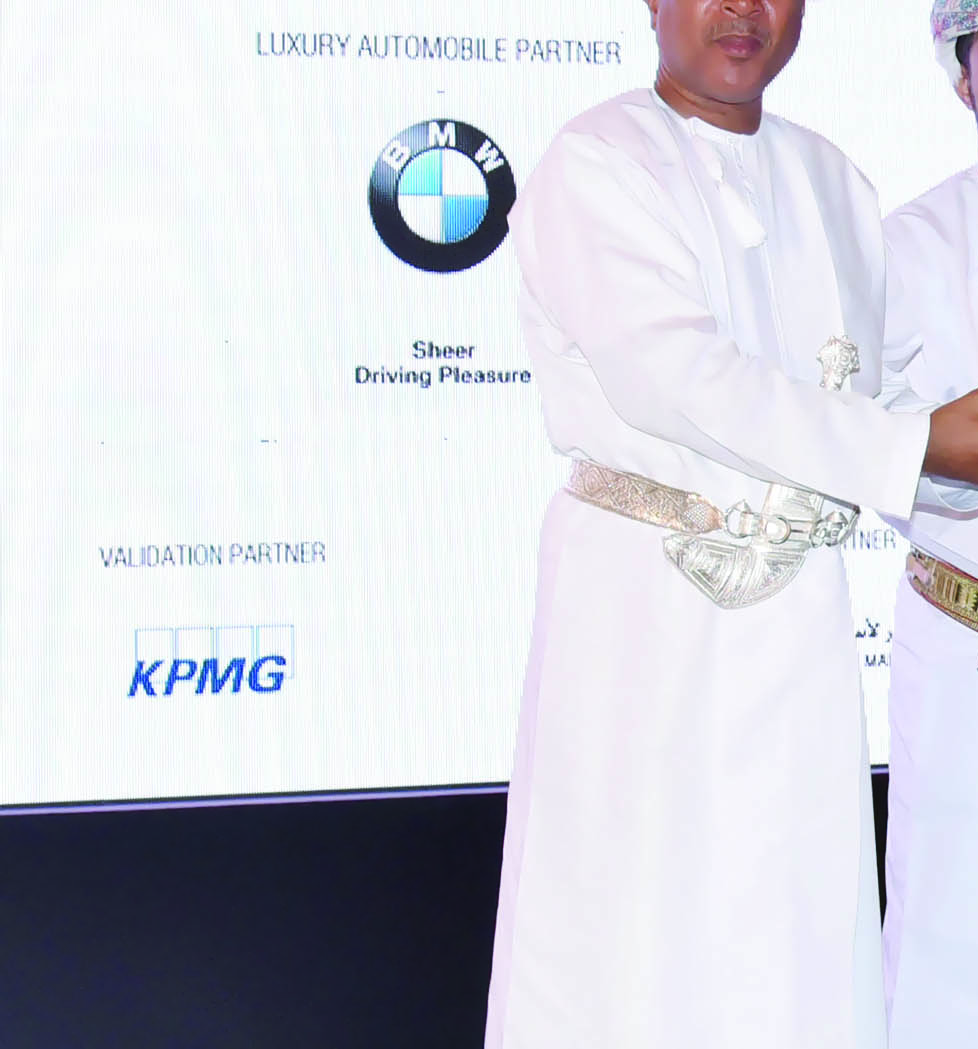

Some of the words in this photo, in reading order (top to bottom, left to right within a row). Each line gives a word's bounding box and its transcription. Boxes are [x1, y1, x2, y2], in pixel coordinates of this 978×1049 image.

[256, 32, 350, 57] LUXURY
[358, 35, 507, 62] AUTOMOBILE
[516, 39, 621, 64] PARTNER
[382, 121, 505, 174] BMW
[412, 341, 475, 360] Sheer
[355, 366, 431, 385] Driving
[438, 366, 532, 384] Pleasure
[99, 544, 222, 568] VALIDATION
[229, 541, 326, 565] PARTNER
[127, 655, 287, 698] KPMG
